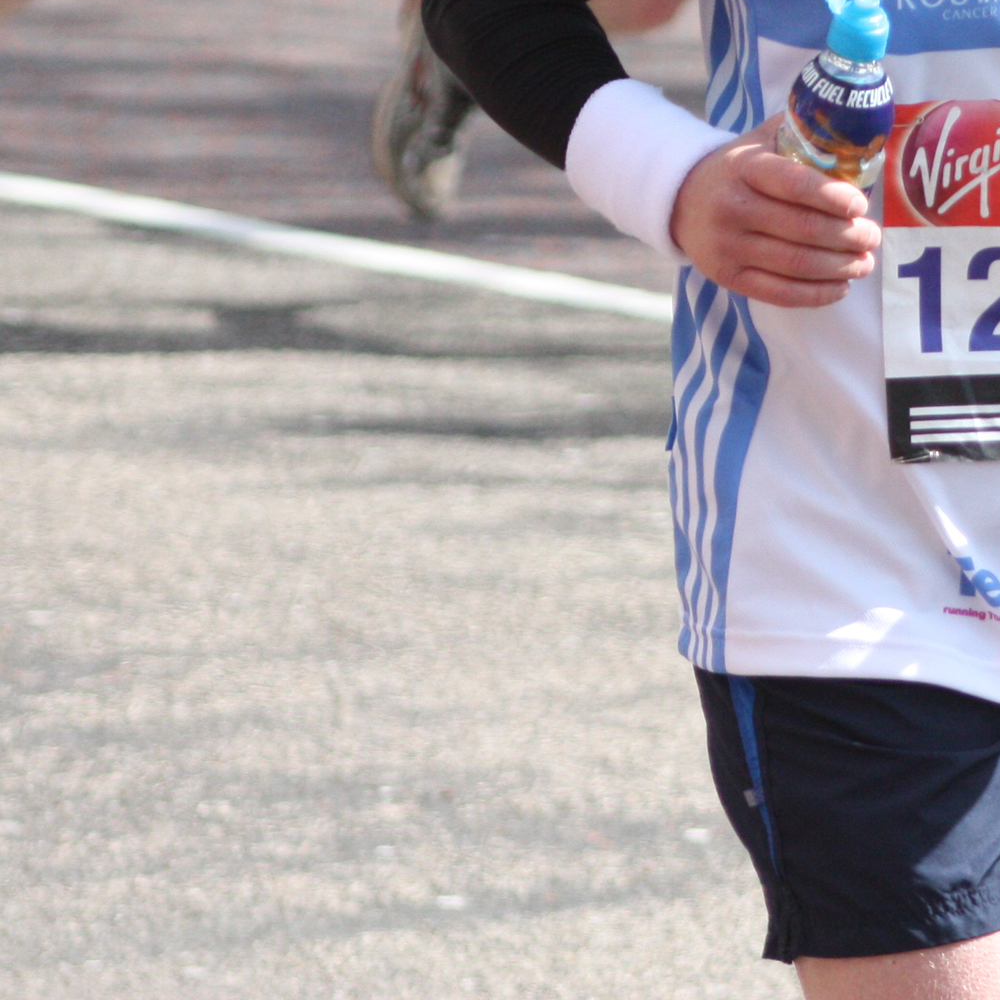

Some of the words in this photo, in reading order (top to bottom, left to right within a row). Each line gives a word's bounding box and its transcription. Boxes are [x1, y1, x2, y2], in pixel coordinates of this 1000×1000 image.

[943, 5, 998, 20] CANCER
[811, 78, 845, 106] FUEL
[943, 606, 986, 621] running
